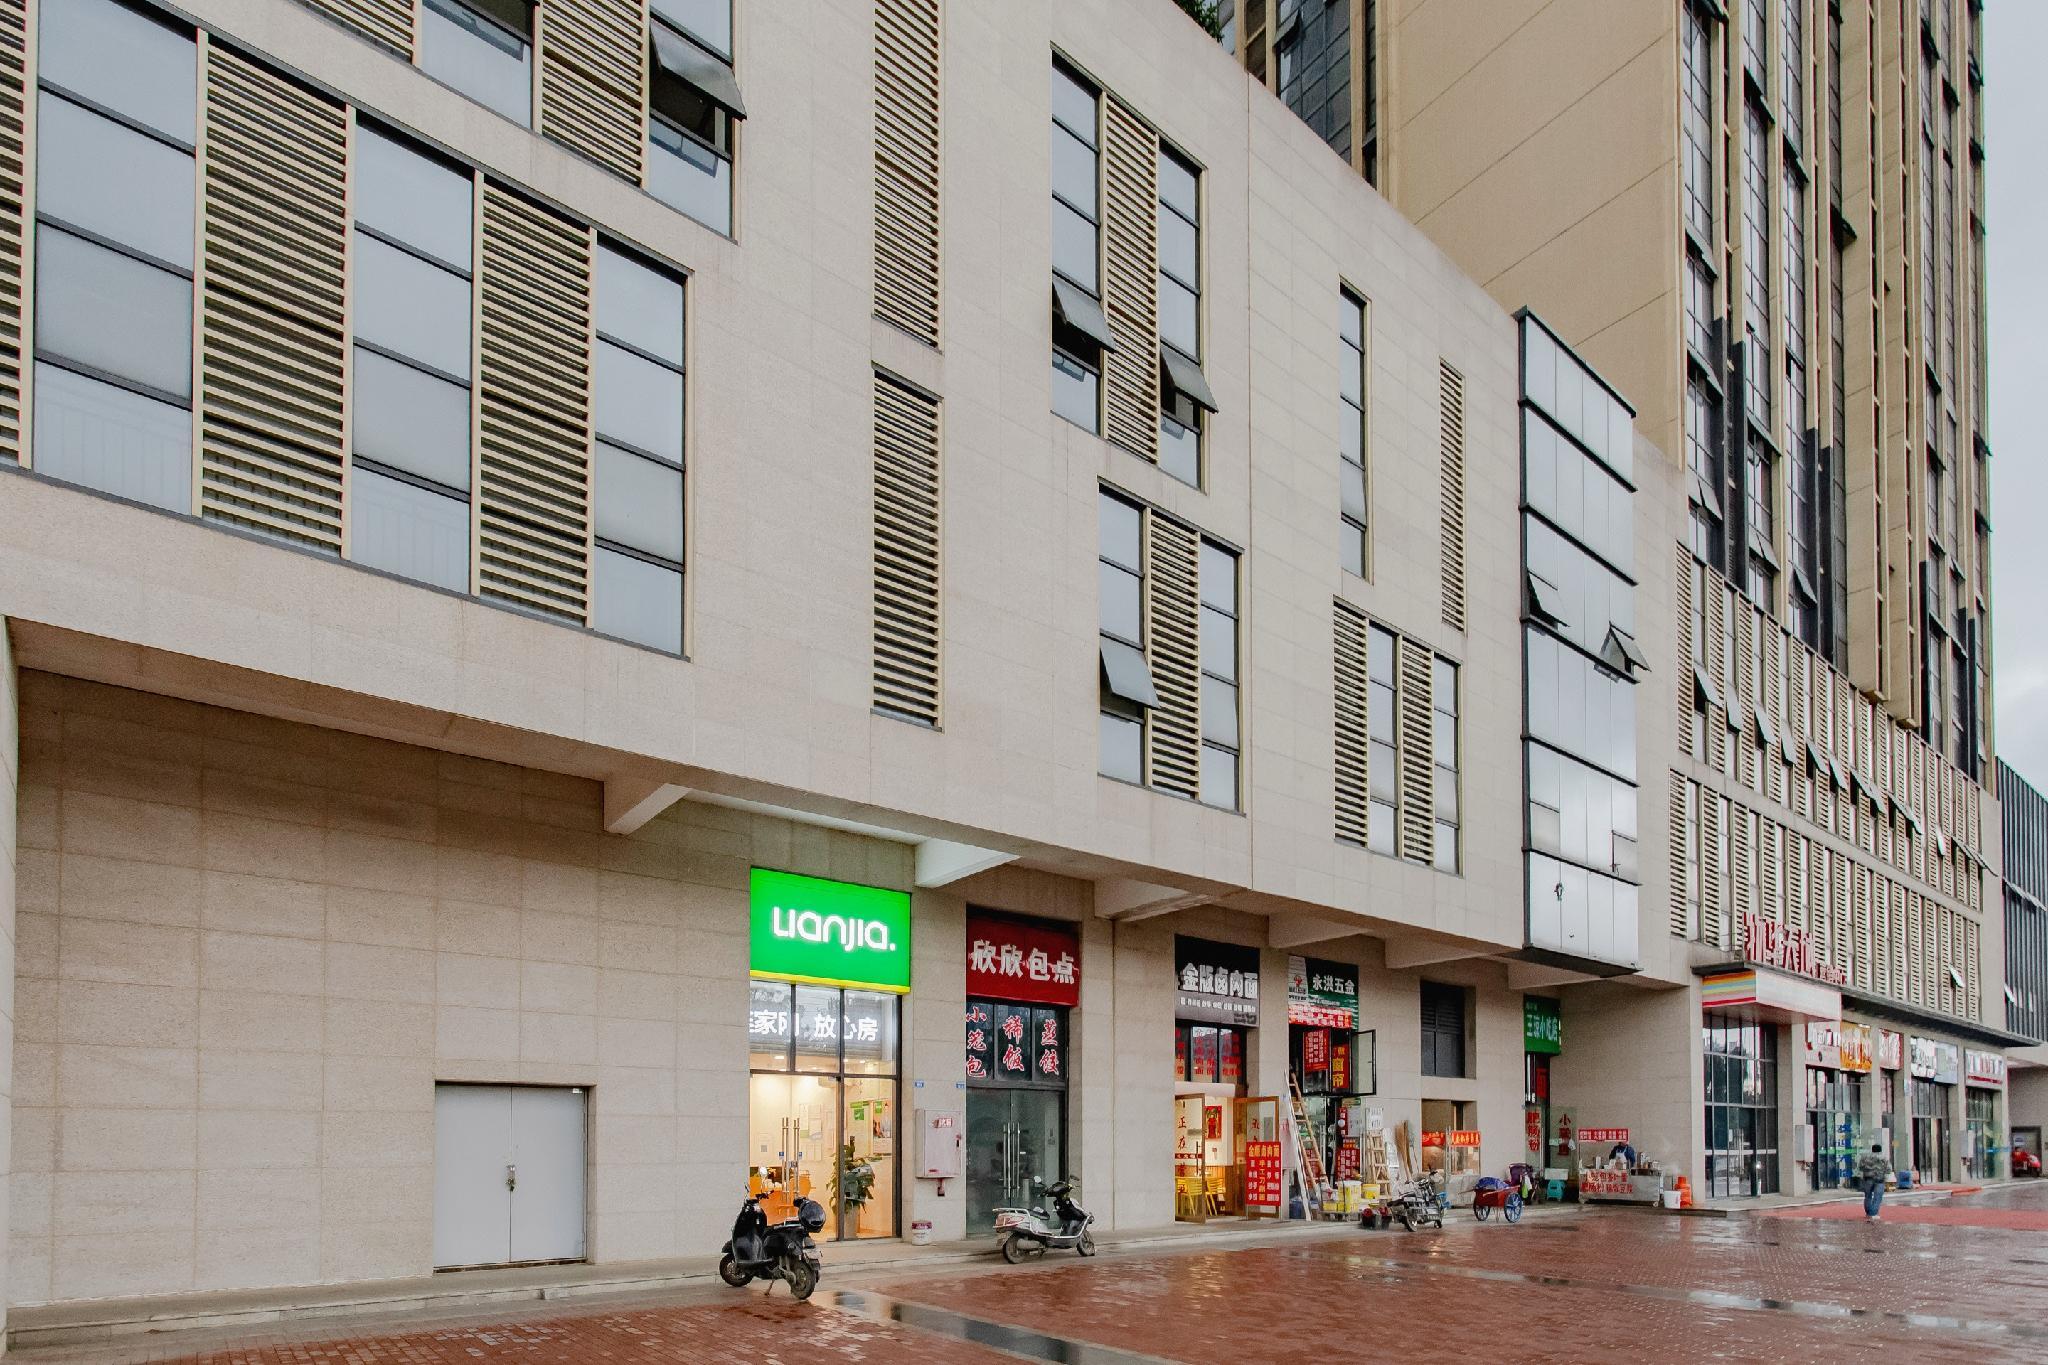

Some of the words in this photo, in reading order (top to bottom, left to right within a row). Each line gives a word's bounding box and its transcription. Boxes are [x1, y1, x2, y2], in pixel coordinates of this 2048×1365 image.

[971, 940, 1075, 984] 欣欣包点
[1182, 963, 1258, 998] 金版卤肉面
[1313, 974, 1355, 996] 永洪五金
[966, 1006, 987, 1077] 小笼包
[1003, 1015, 1024, 1071] 稀饭
[1039, 1019, 1059, 1075] 蒸饺
